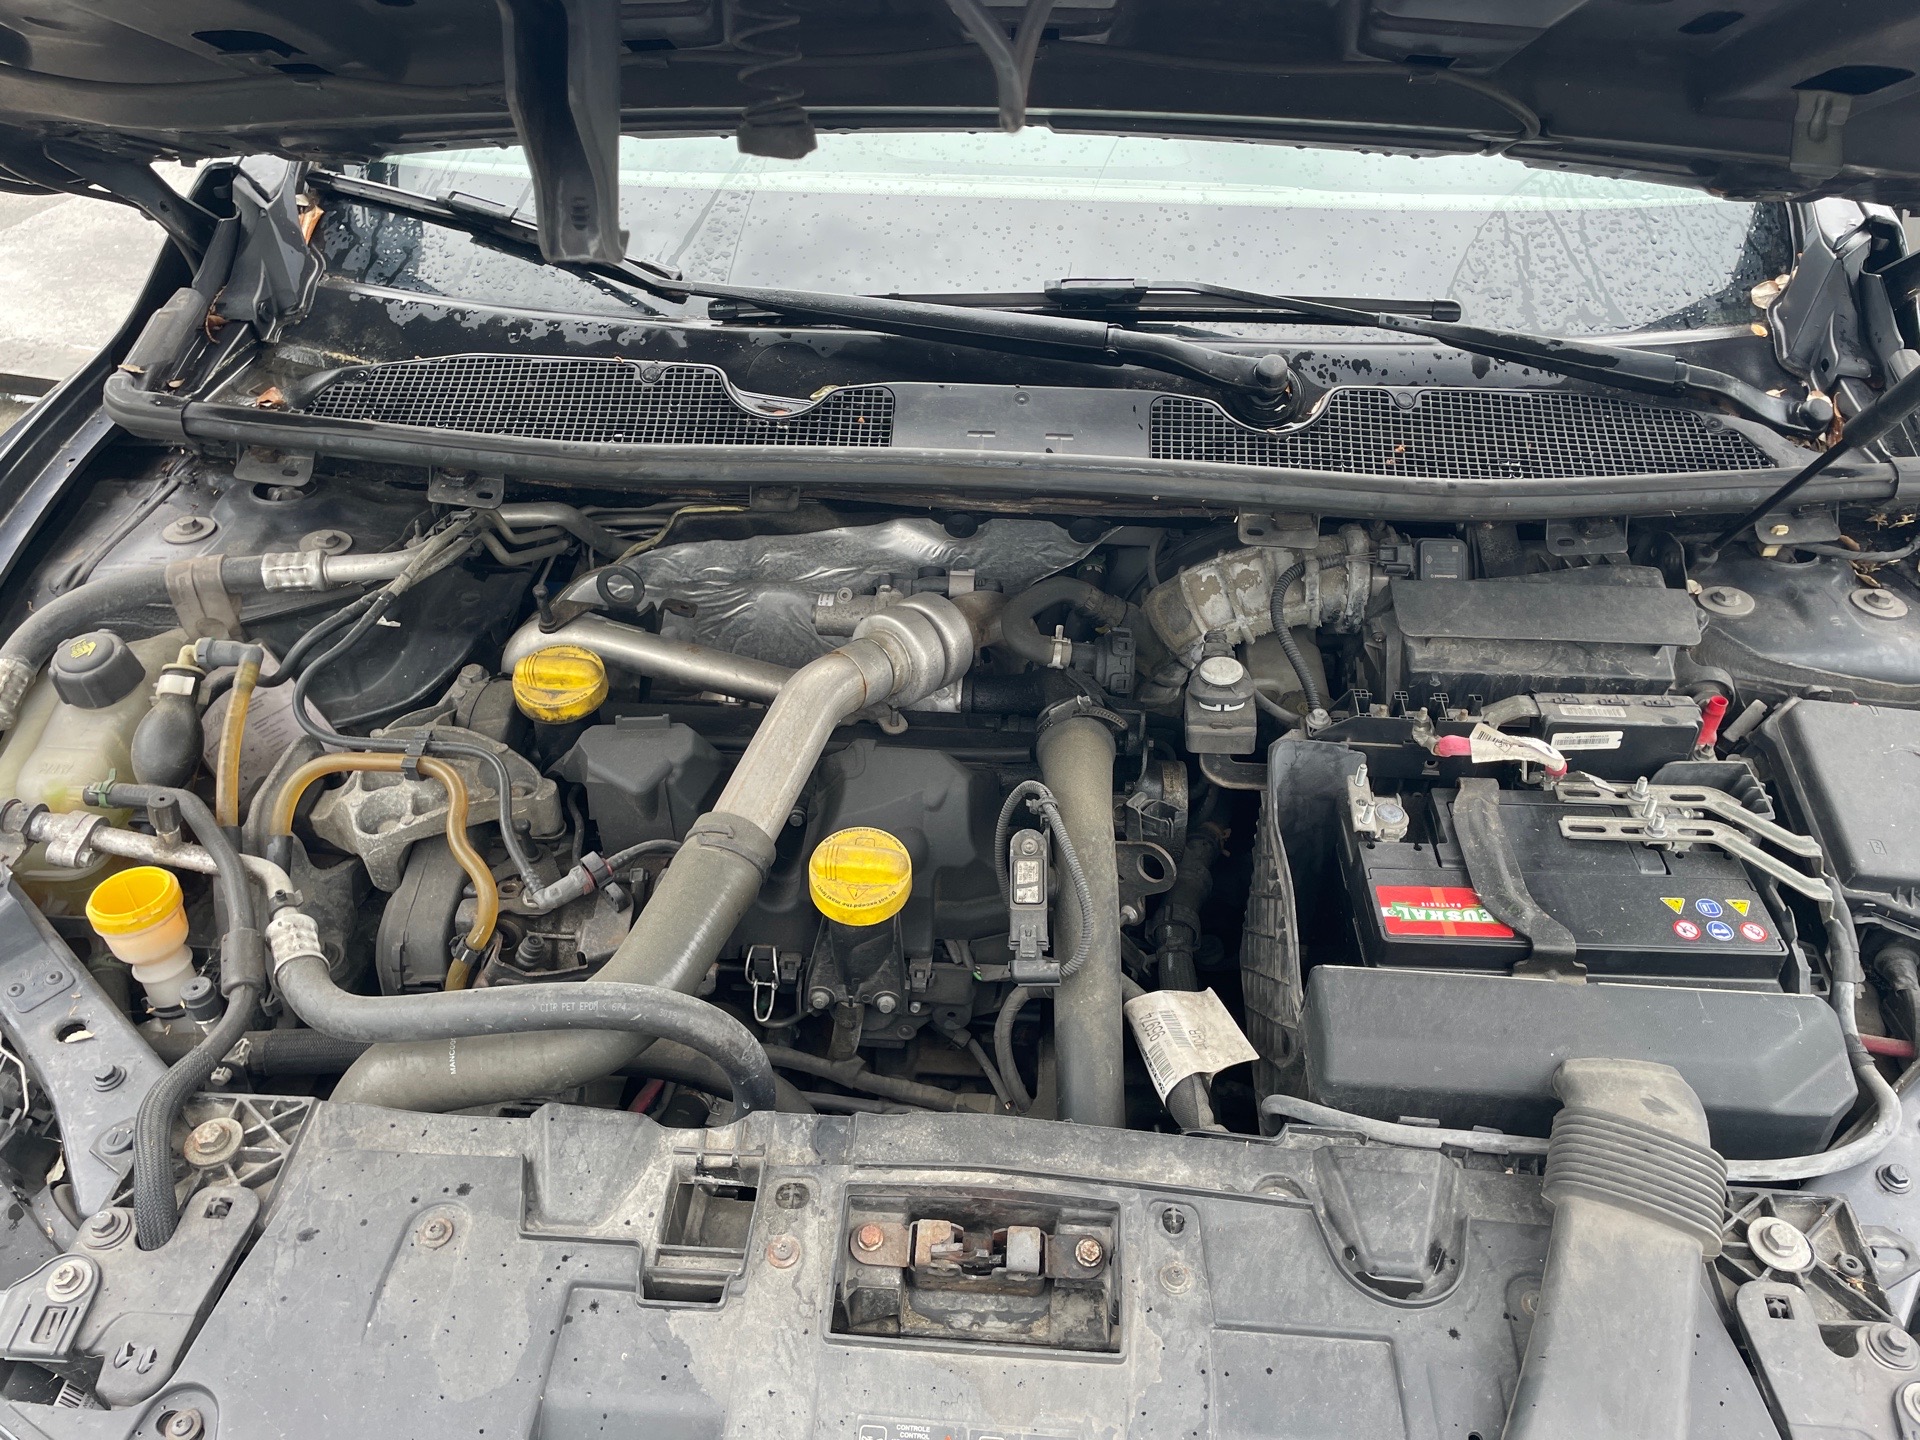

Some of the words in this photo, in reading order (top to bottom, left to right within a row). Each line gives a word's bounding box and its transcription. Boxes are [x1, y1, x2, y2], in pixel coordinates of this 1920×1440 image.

[1395, 905, 1495, 922] EUSKAL
[561, 1002, 576, 1012] PET
[579, 1001, 599, 1012] EPDM
[1139, 1012, 1166, 1042] 95974
[896, 1424, 931, 1432] CONTROLE
[899, 1431, 931, 1440] CONTROL
